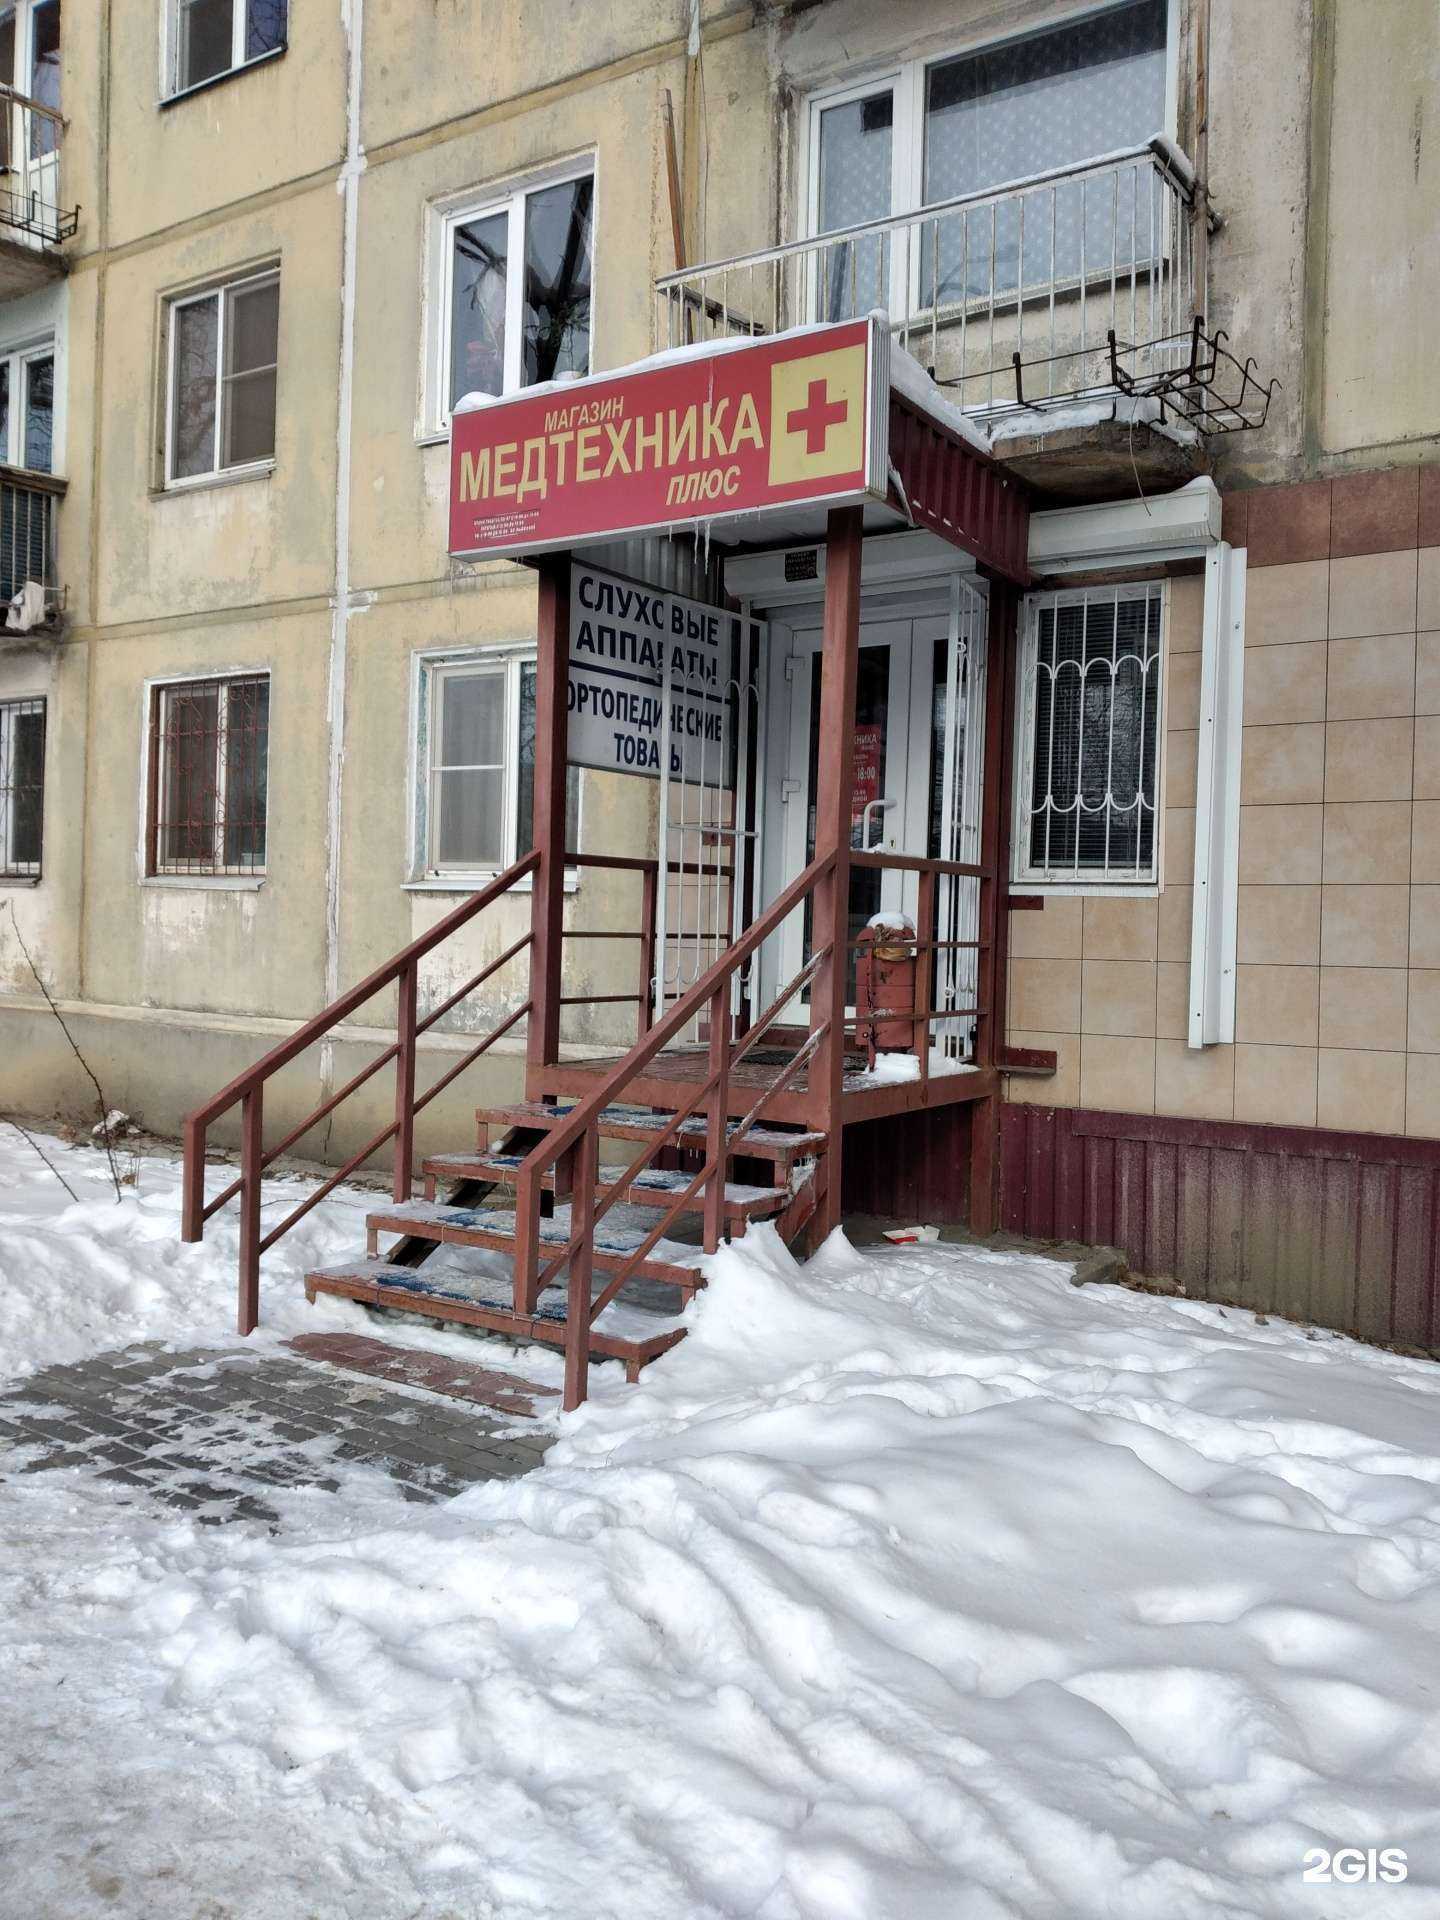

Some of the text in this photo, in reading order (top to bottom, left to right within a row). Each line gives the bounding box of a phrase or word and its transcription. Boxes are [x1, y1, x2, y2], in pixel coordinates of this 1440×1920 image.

[544, 395, 625, 433] МАГАЗИН
[458, 392, 765, 503] МЕДТЕХНИКА
[665, 465, 741, 506] ПЛЮС
[578, 576, 719, 647] СЛУХОВЫЕ
[613, 733, 683, 773] ТОВАЫ
